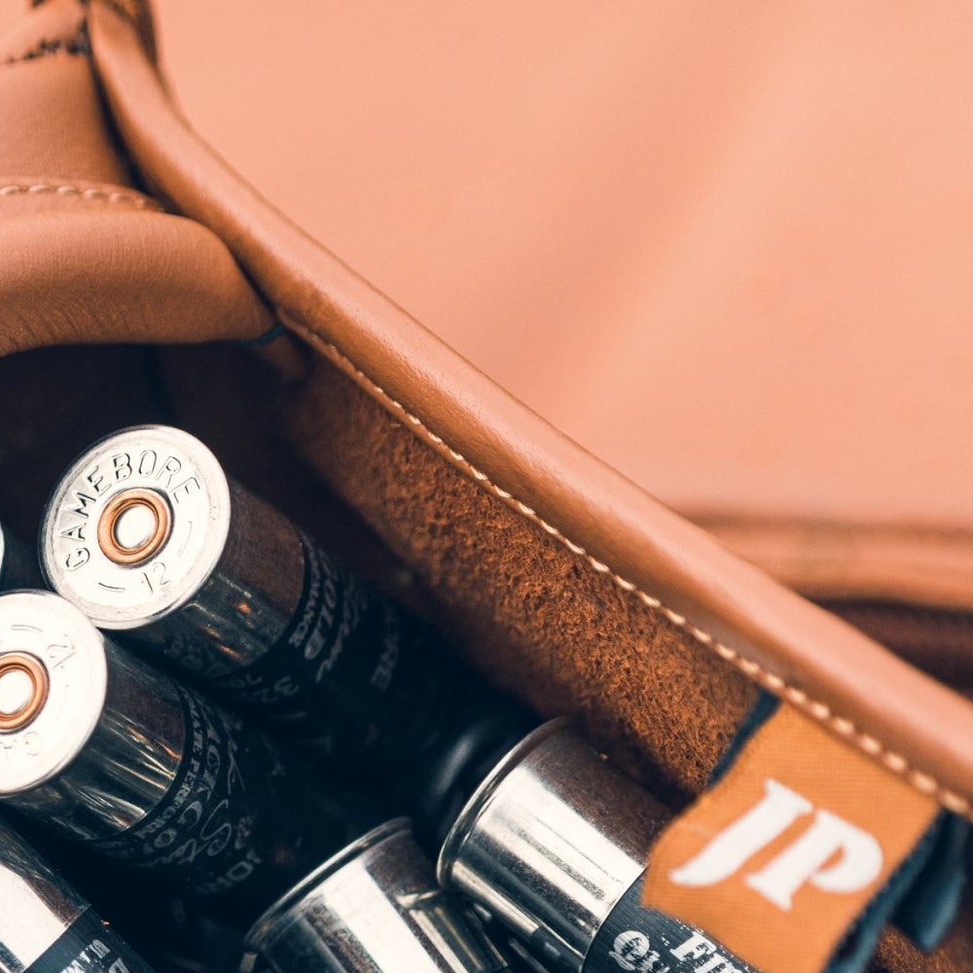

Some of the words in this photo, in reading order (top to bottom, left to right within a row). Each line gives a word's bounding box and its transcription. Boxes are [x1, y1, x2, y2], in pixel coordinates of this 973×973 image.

[60, 449, 201, 571] GAMEBORE
[141, 561, 172, 595] 12
[669, 777, 884, 911] JP
